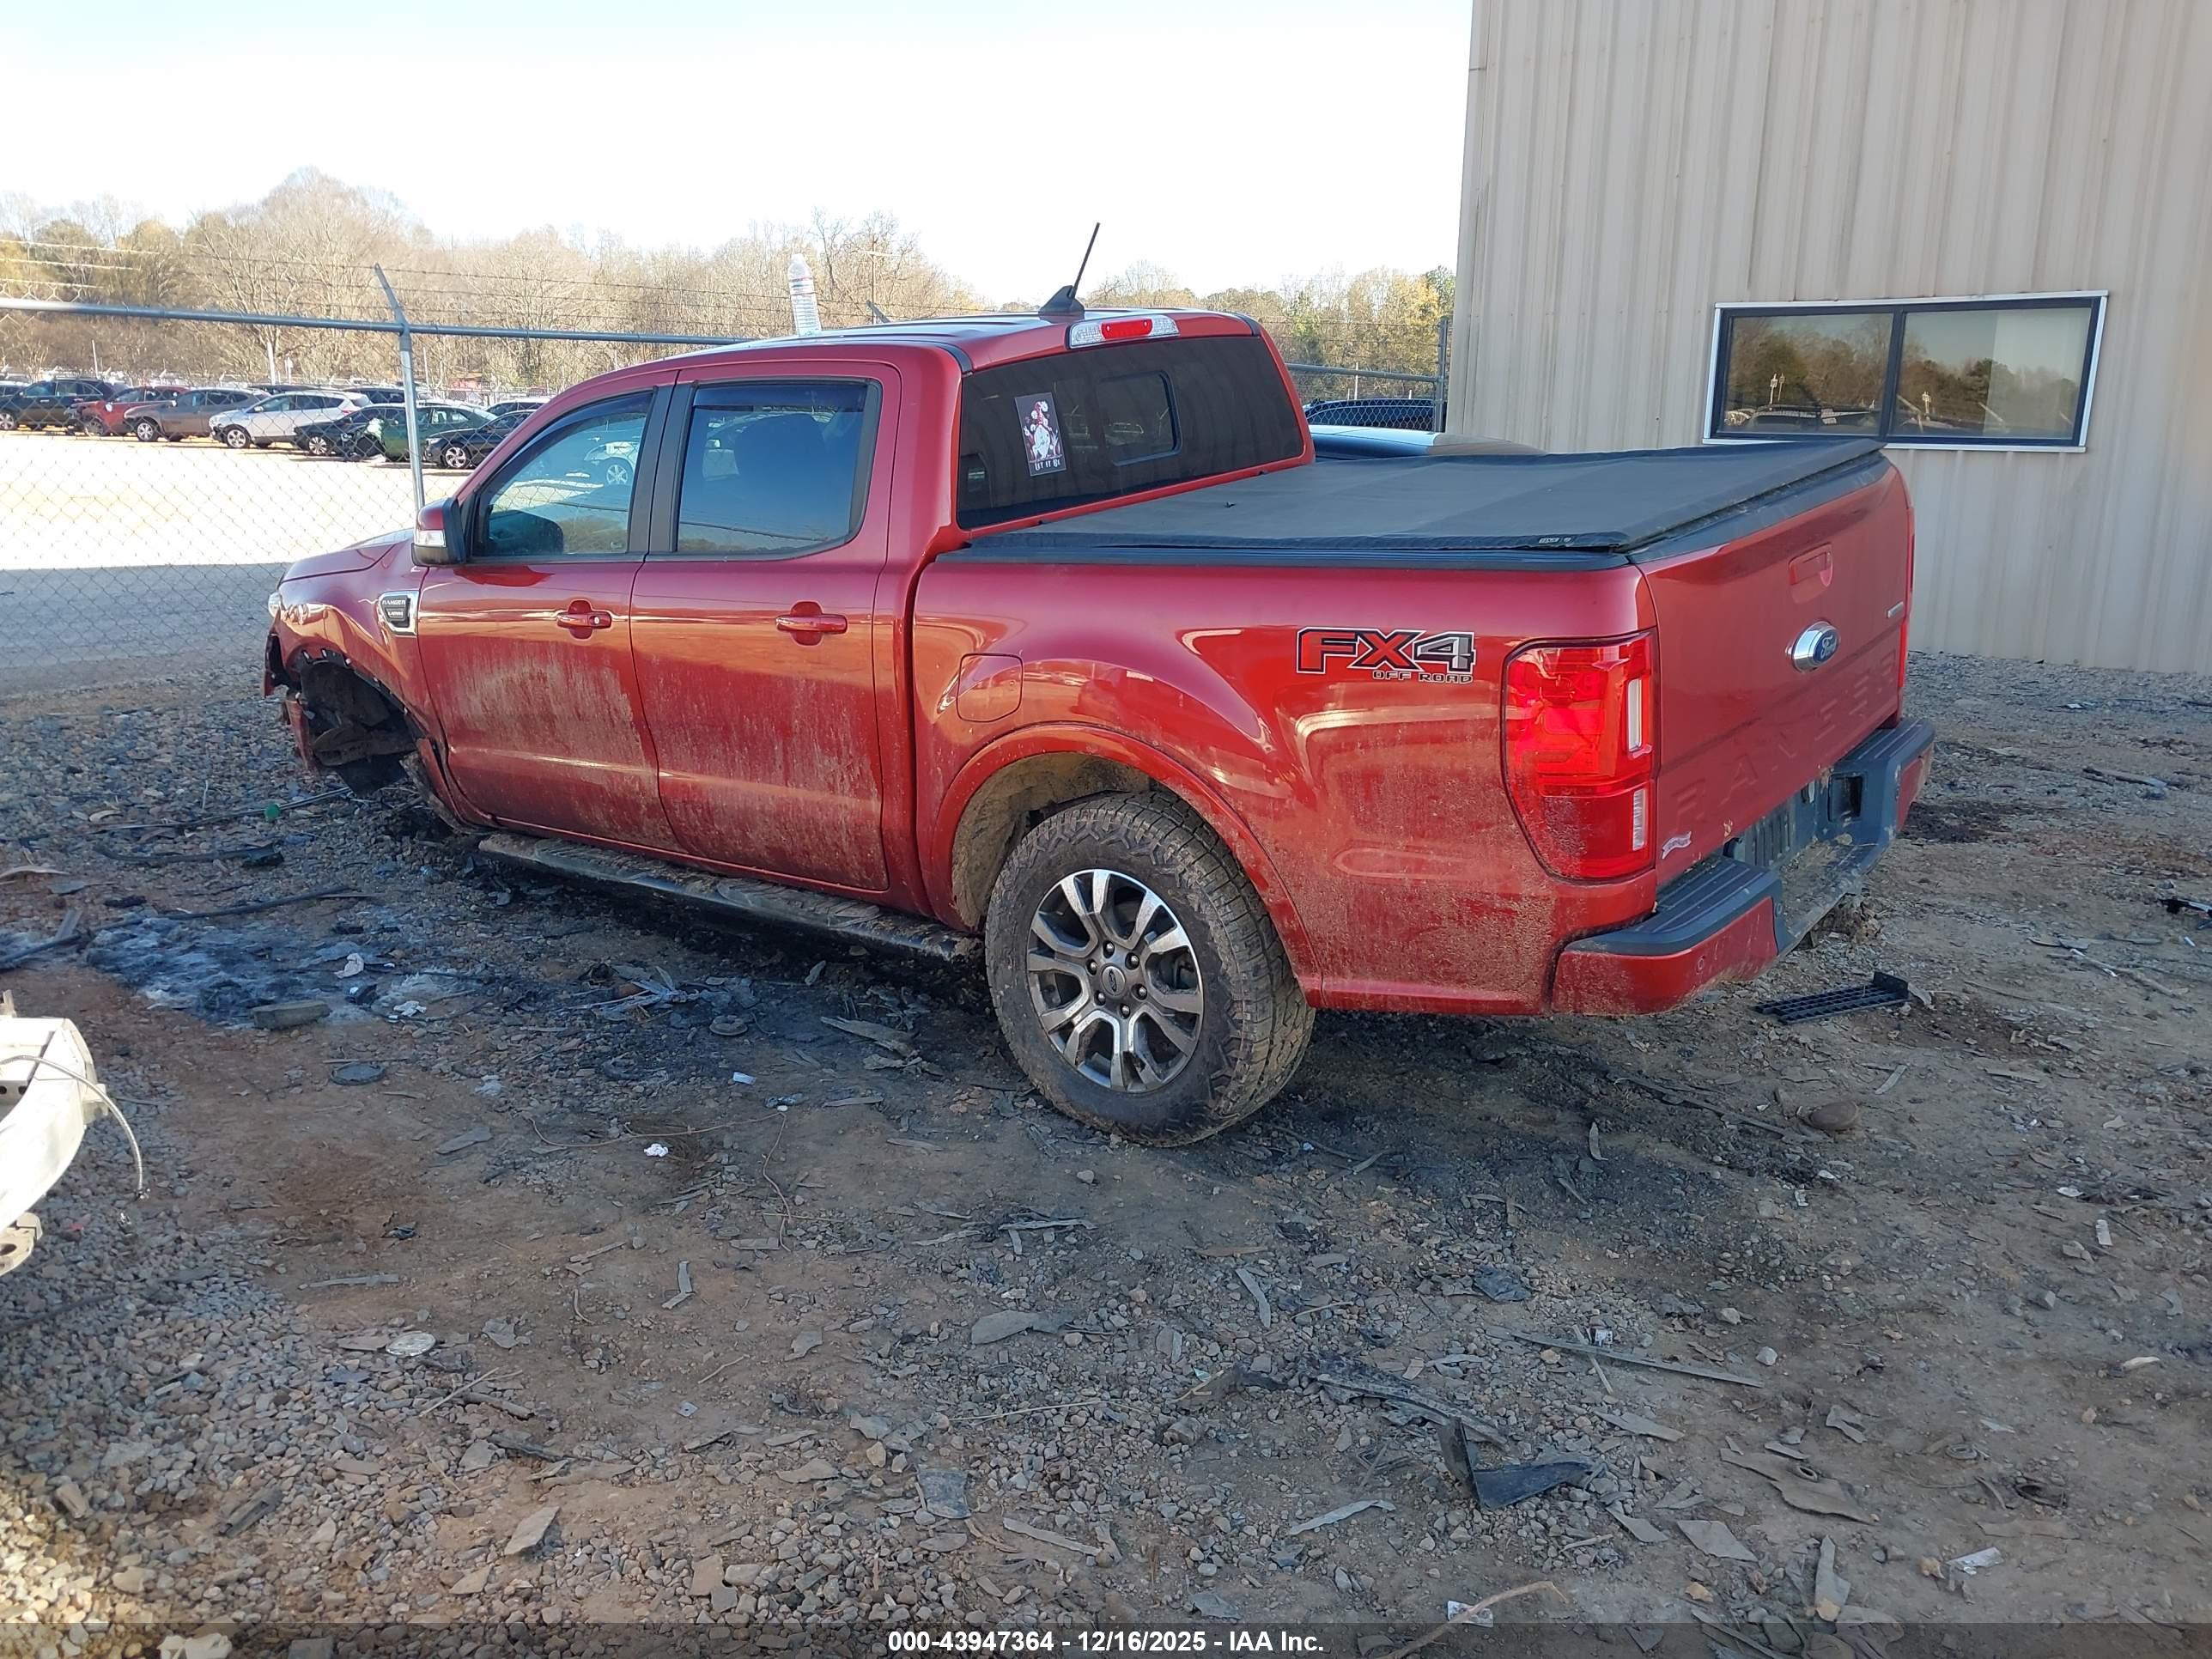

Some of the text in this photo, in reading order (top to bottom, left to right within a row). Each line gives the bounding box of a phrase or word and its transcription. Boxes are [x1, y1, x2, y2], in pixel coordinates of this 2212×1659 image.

[1296, 626, 1476, 674] FX4
[1372, 671, 1474, 684] OFF ROAD
